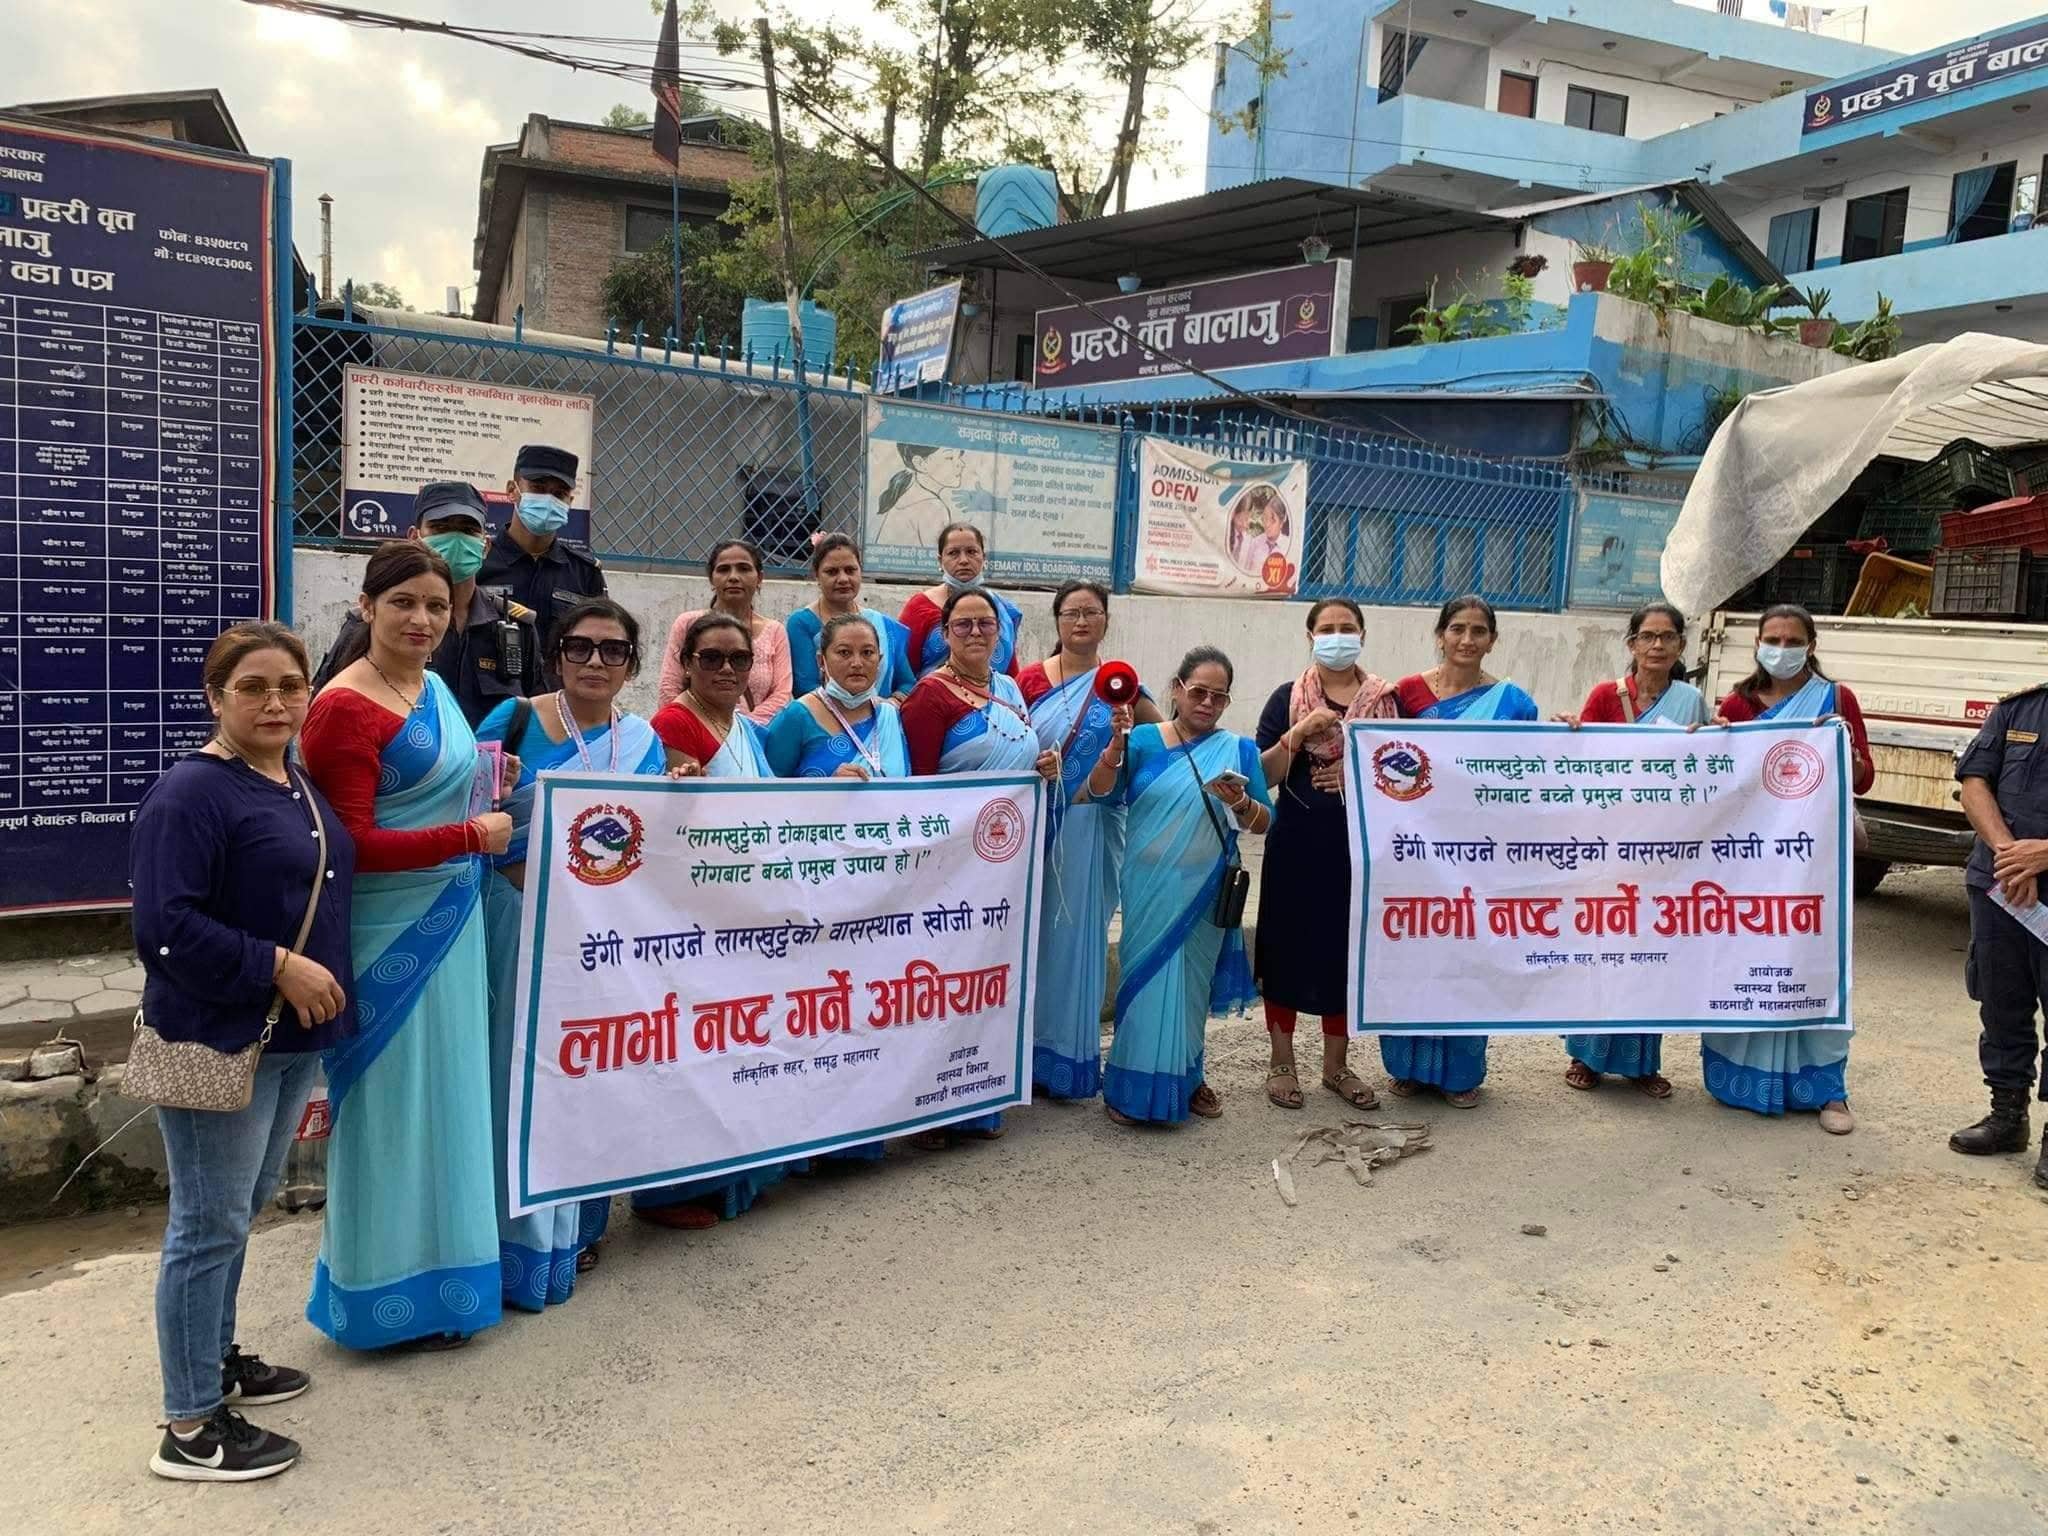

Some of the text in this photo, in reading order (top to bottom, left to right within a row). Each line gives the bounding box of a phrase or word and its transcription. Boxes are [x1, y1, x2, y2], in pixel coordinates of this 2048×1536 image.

[1840, 73, 1919, 117] प्रहरी
[1928, 58, 1977, 93] वृत्त
[21, 196, 136, 234] प्रहरी वृत्त
[11, 260, 116, 291] वडा पत्र
[1070, 300, 1281, 367] प्रहरी वृत्त बालाजु
[351, 374, 379, 385] प्रहरी
[466, 386, 513, 401] सम्बन्धित
[566, 398, 590, 412] लागि
[1152, 479, 1198, 502] OPEN
[1082, 565, 1110, 576] SCHOOL
[1554, 755, 1632, 777] टोकाइबाट
[1641, 758, 1678, 781] बच्नु
[1684, 755, 1699, 776] नै
[1707, 754, 1735, 777] डेंगी
[1474, 785, 1532, 808] रोगबाट
[1540, 786, 1575, 805] बच्ने
[1582, 786, 1622, 810] प्रमुख
[1632, 786, 1672, 806] उपाय
[0, 813, 28, 830] म्पूर्ण
[81, 811, 126, 824] नितान्त
[779, 823, 846, 845] टोकाइबाट
[854, 821, 891, 847] बच्नु
[897, 817, 911, 840] नै
[919, 816, 951, 840] डेंगी
[1393, 833, 1815, 870] डेंगी गराउने लामखुट्टेको वासस्थान खोजी गरी
[691, 859, 754, 889] रोगबाट
[761, 861, 793, 882] बच्ने
[798, 860, 836, 887] प्रमुख
[844, 854, 885, 878] उपाय
[1382, 880, 1825, 942] लार्भा नष्ट गर्ने अभियान
[580, 898, 1011, 972] डेंगी गराउने लामखुट्टेको वासस्थान खोजी गरी
[1525, 950, 1669, 969] साँस्कृतिक सहर, समृद्ध महानगर
[1749, 965, 1794, 977] आयोजक
[1734, 981, 1807, 994] स्वास्थ्य विभाग
[559, 960, 1011, 1078] लार्भा नष्ट गर्ने अभियान
[1759, 998, 1827, 1012] महानगरपालिका
[733, 1048, 880, 1085] साँस्कृतिक सहर, समृद्ध महानगर
[949, 1045, 979, 1062] आयोजक
[936, 1061, 989, 1084] स्वास्थ्य विभाग
[951, 1075, 1006, 1097] महानगरपालिका
